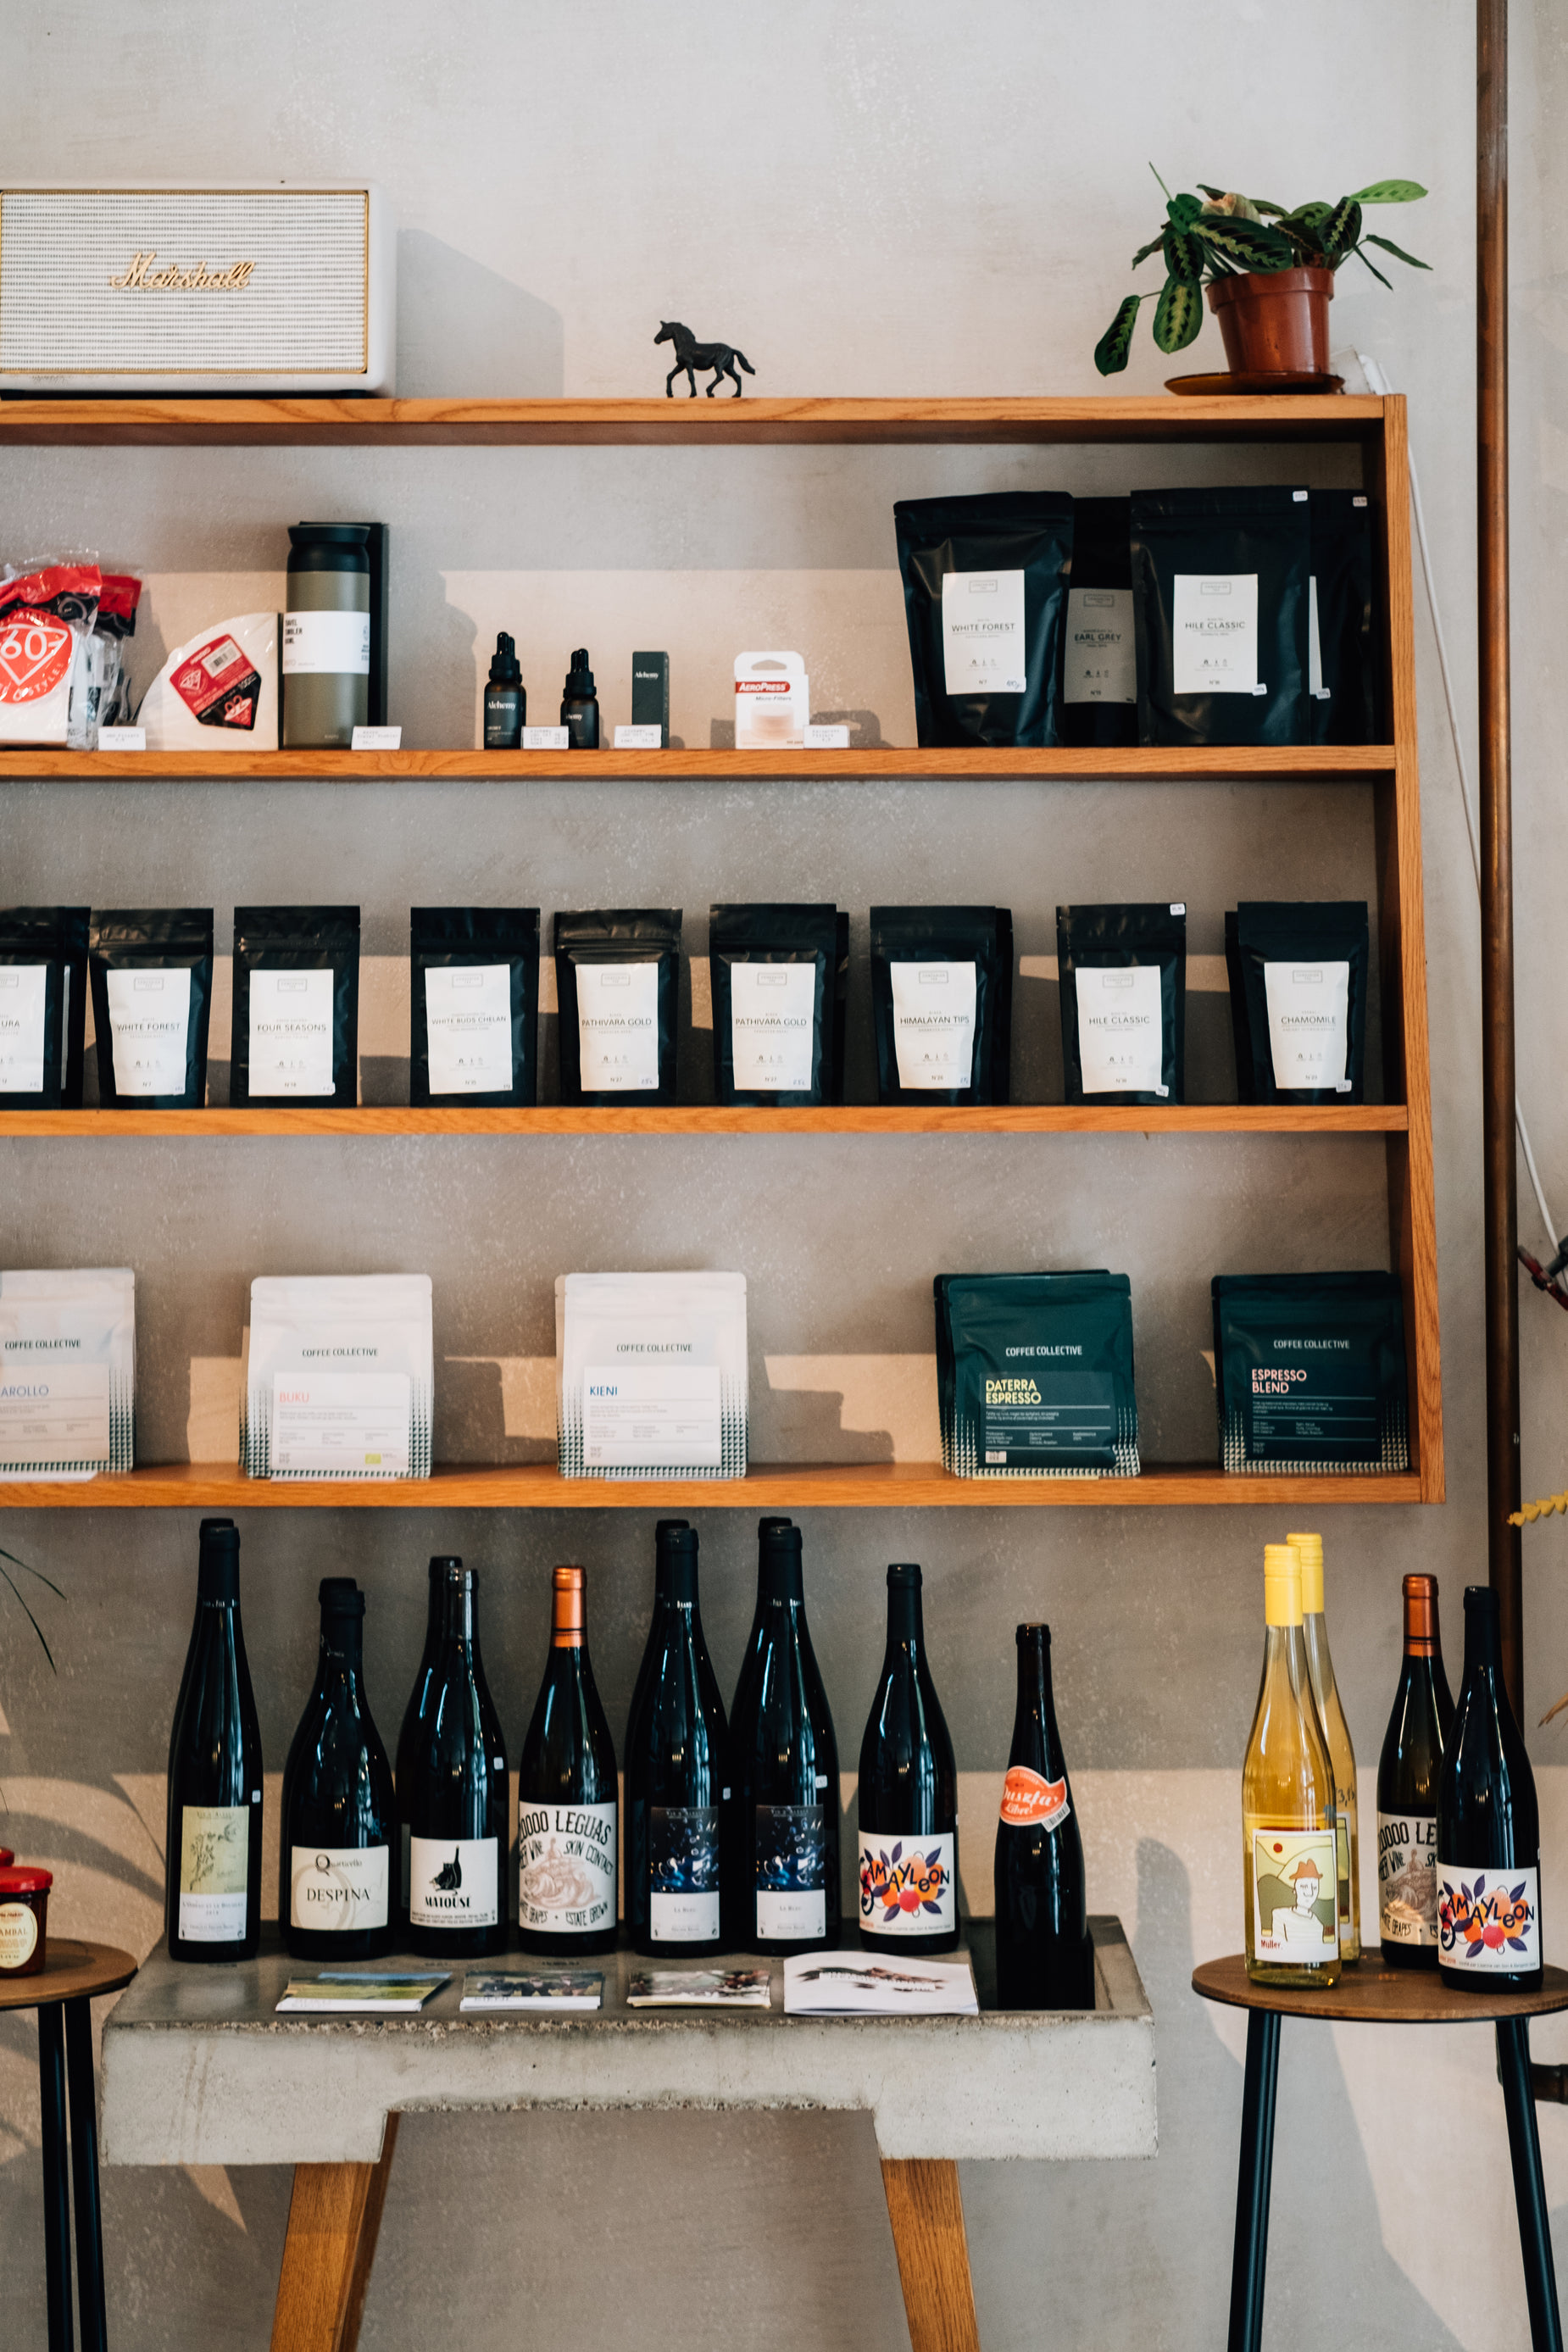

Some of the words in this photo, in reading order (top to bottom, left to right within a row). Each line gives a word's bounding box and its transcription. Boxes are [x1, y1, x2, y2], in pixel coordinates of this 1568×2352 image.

[109, 252, 255, 290] Marshall
[952, 624, 979, 632] WHITE
[982, 623, 1015, 631] FOREST
[1075, 633, 1095, 642] EARL
[635, 671, 659, 680] Alchemy
[488, 700, 516, 711] Alchemy
[900, 1016, 951, 1025] HIMALAYAN
[117, 1023, 143, 1031] WHITE
[5, 1340, 33, 1350] COFFEE
[35, 1339, 81, 1349] COLLECTIVE
[616, 1343, 645, 1353] COFFEE
[647, 1343, 692, 1353] COLLECTIVE
[1273, 1340, 1303, 1349] COFFEE
[1304, 1340, 1350, 1349] COLLECTIVE
[302, 1348, 331, 1357] COFFEE
[332, 1348, 379, 1356] COLLECTIVE
[1005, 1346, 1035, 1357] COFFEE
[1036, 1345, 1082, 1356] COLLECTIVE
[1252, 1369, 1307, 1382] ESPRESSO
[986, 1379, 1037, 1392] DATERRA
[1252, 1382, 1289, 1393] BLEND
[590, 1386, 618, 1397] KIENI
[279, 1392, 310, 1404] BUKU
[986, 1392, 1042, 1405] ESPRESSO
[555, 1810, 612, 1846] LEGUAS
[564, 1840, 585, 1856] SKIN
[307, 1888, 370, 1901] DESPINA
[565, 1910, 587, 1927] ESTATE
